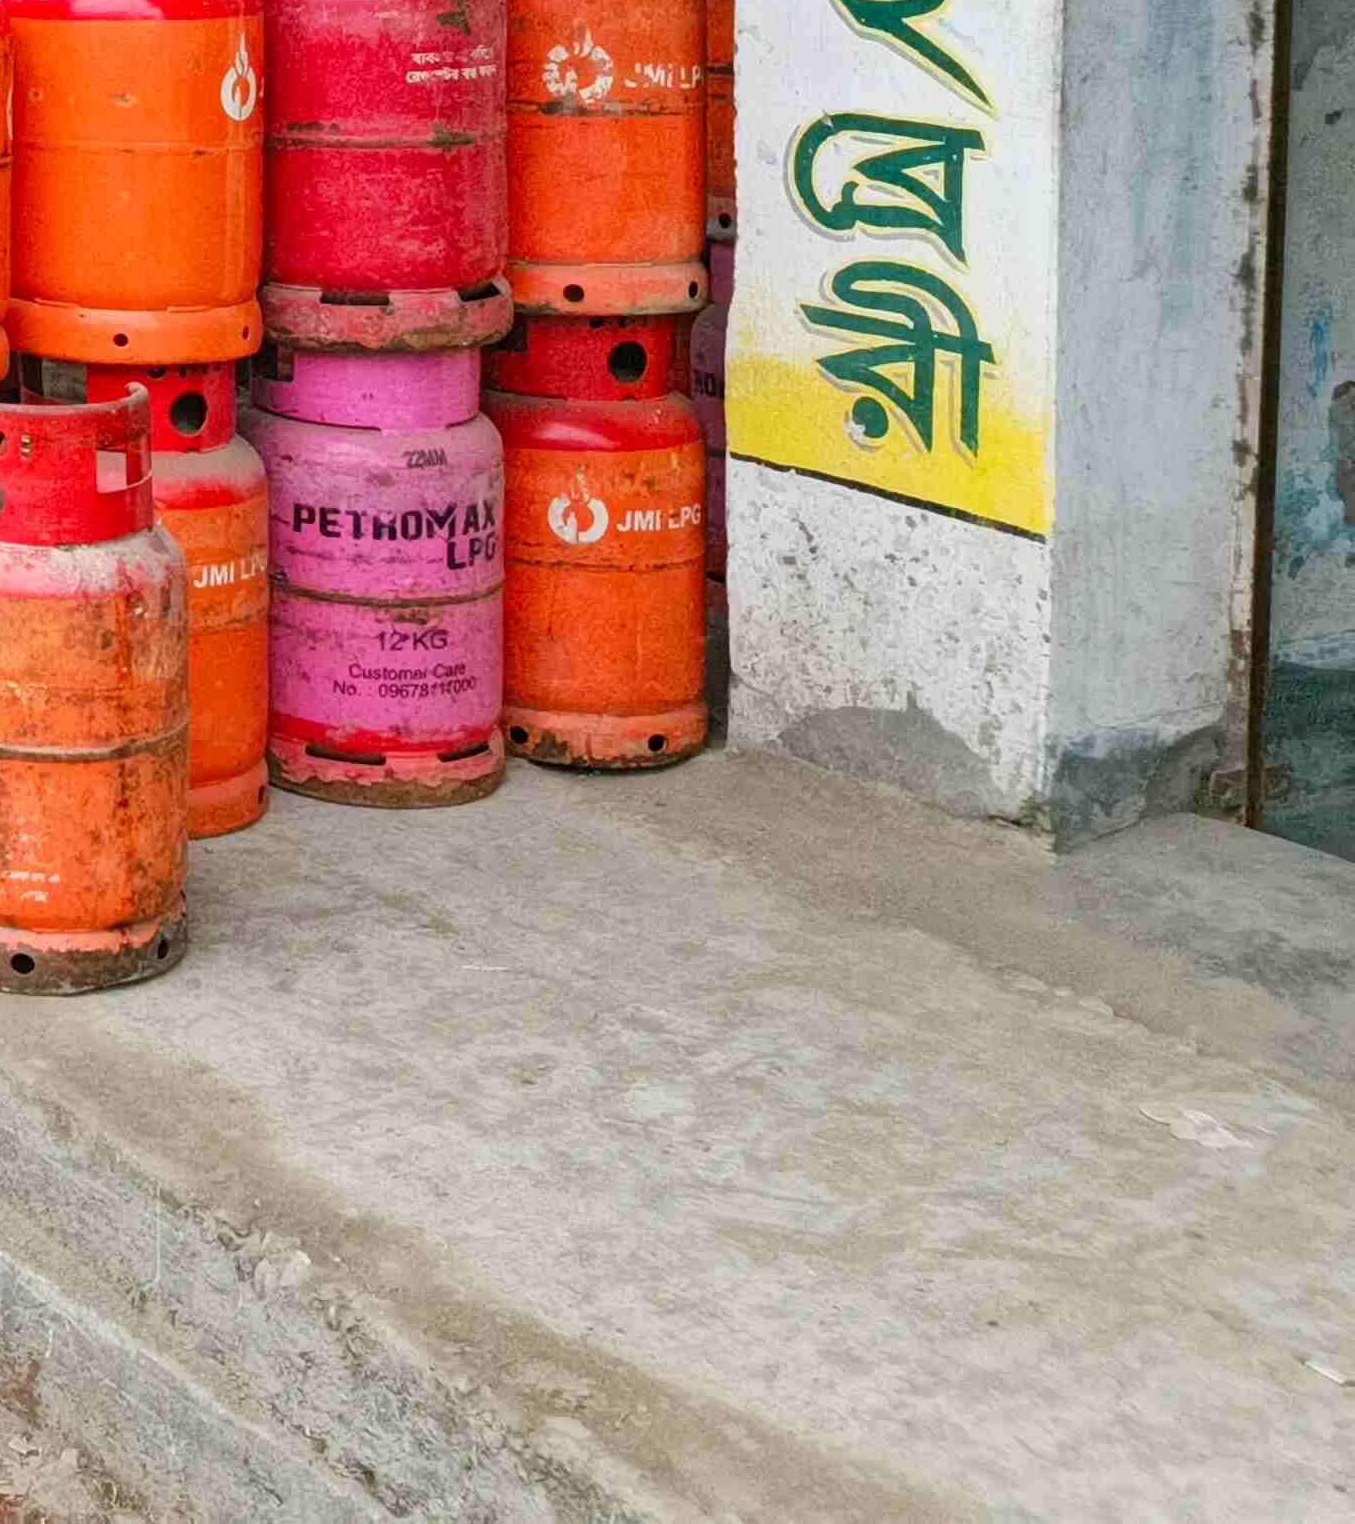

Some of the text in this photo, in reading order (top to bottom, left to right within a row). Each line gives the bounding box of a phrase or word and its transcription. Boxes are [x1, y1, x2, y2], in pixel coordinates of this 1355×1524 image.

[402, 449, 449, 471] 22MM
[291, 500, 495, 542] PETROMAX
[616, 507, 663, 533] JMI
[445, 531, 498, 572] LPG
[193, 564, 236, 590] JMI
[411, 630, 449, 653] KG
[347, 661, 467, 681] Customer Care
